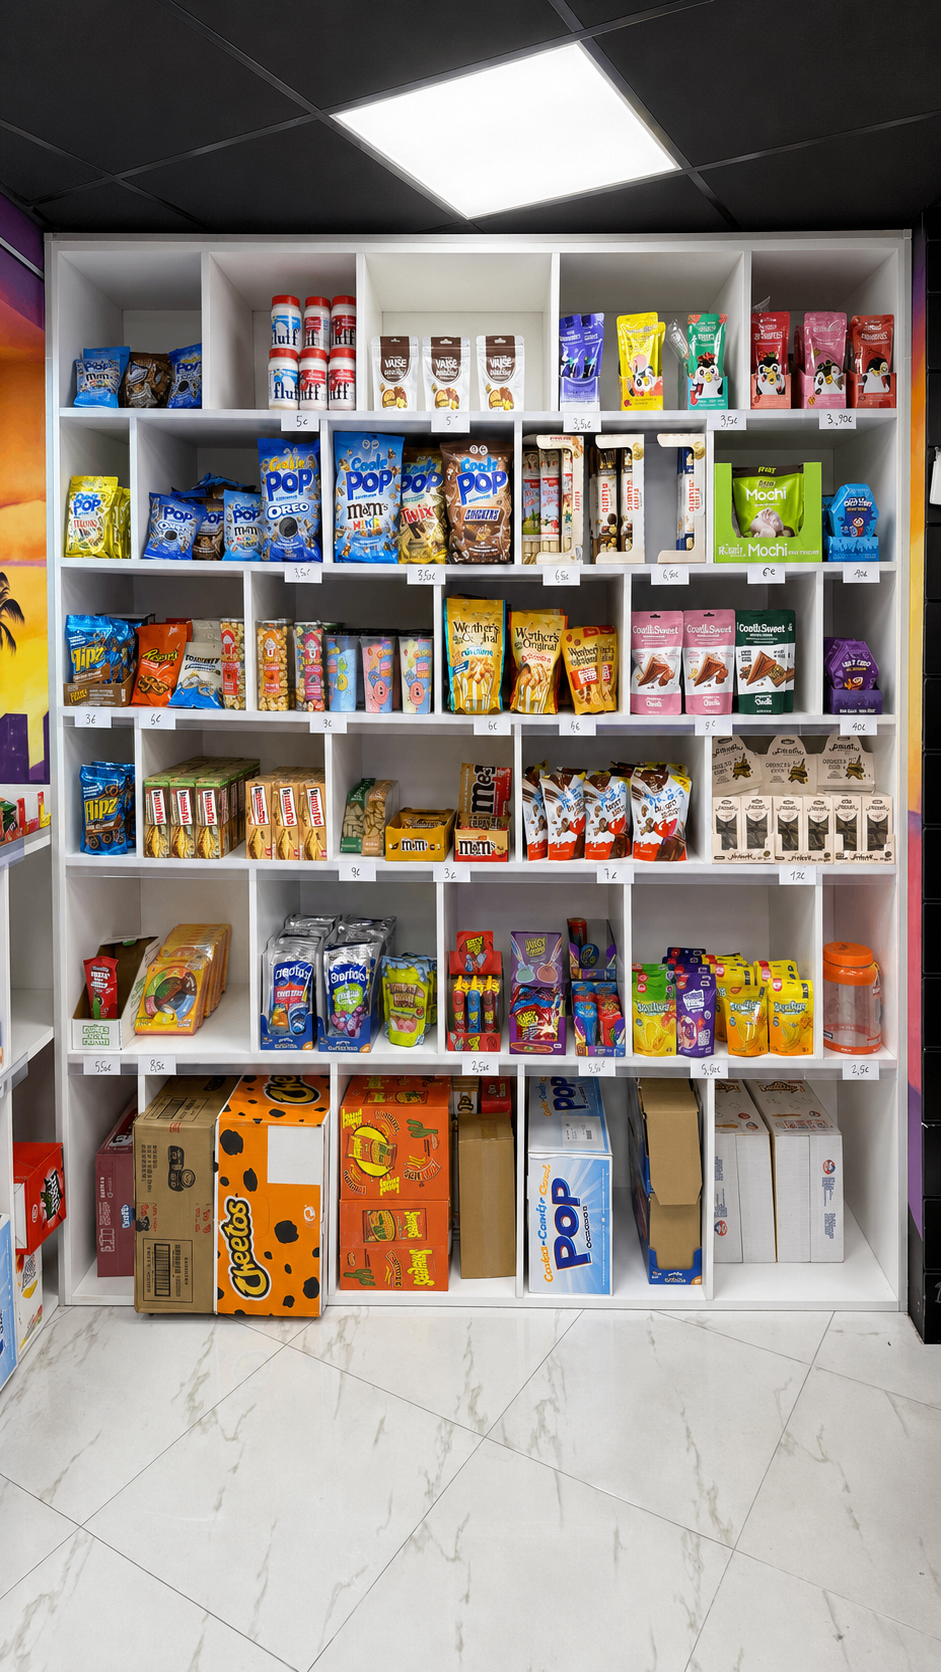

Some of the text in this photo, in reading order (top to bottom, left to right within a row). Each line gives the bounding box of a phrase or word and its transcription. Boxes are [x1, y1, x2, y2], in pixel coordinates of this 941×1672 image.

[265, 468, 313, 502] POP
[345, 469, 393, 501] POP
[456, 470, 509, 506] POP
[746, 486, 787, 502] Mochi
[267, 502, 309, 519] OREO
[747, 542, 788, 557] Mochi
[550, 1176, 593, 1271] POP
[221, 1196, 270, 1300] Cheetos
